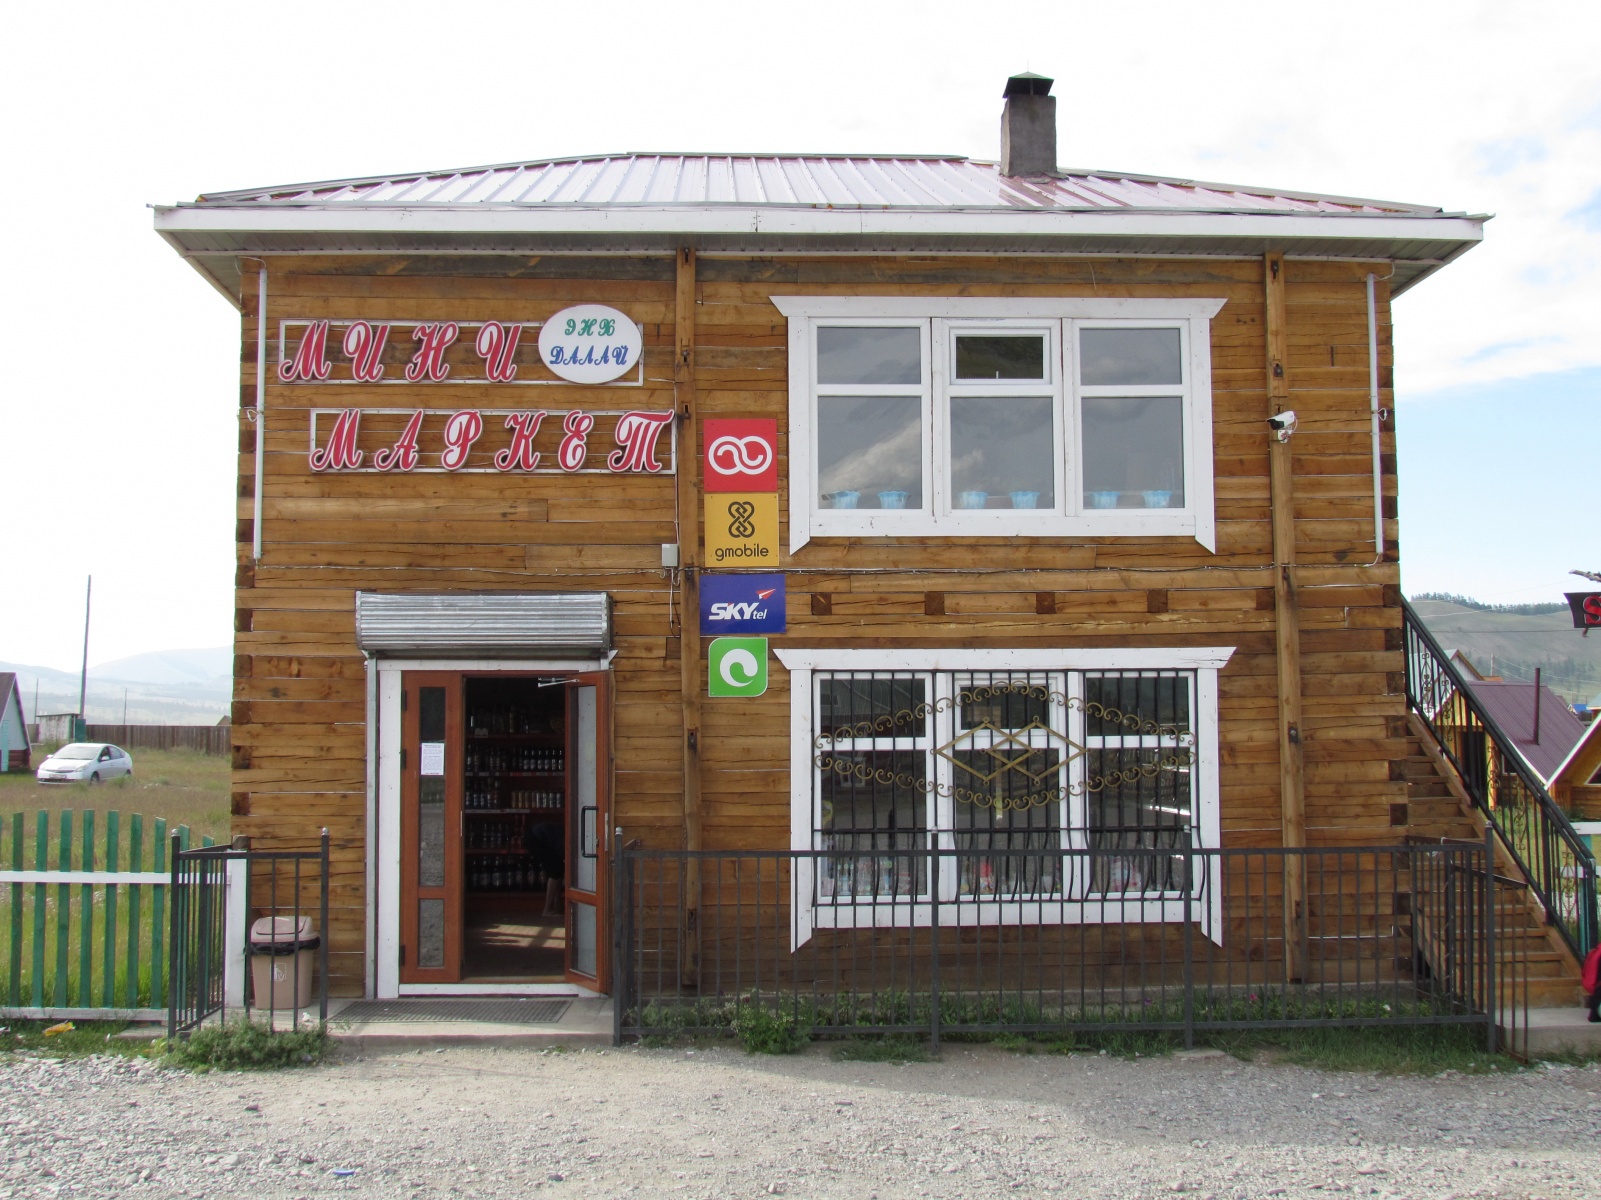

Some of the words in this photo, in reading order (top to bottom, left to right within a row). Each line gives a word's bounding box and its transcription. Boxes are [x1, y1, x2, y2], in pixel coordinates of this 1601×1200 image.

[564, 318, 616, 337] ЭНХ
[278, 319, 522, 383] МИНИ
[549, 344, 629, 366] ДАЛАЙ
[309, 408, 675, 474] МАРКЕТ
[714, 543, 769, 562] gmobile
